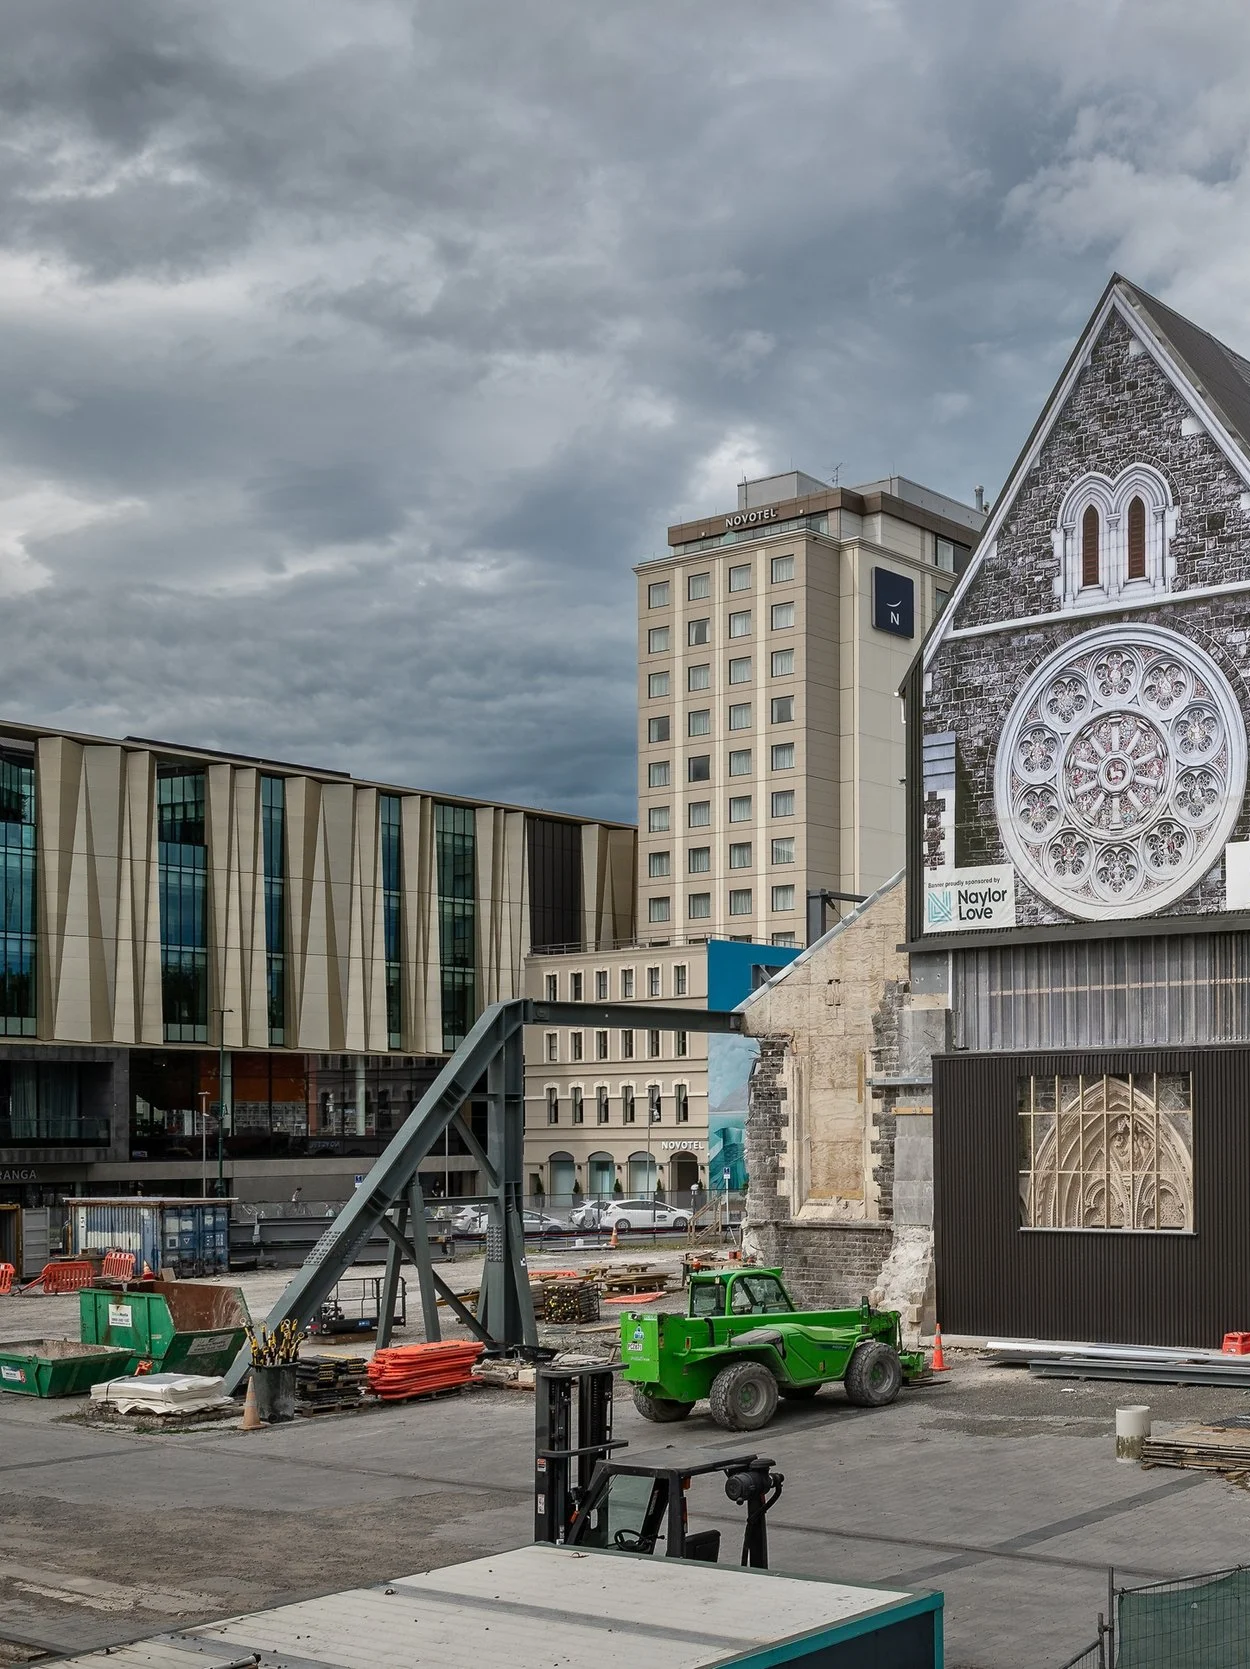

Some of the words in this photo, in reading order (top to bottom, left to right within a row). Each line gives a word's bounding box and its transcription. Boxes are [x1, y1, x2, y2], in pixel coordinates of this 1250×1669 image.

[725, 508, 777, 527] NOVOTEL
[890, 611, 900, 625] N
[945, 880, 964, 888] proudly
[965, 877, 993, 886] sponsored
[958, 888, 1007, 907] Naylor
[959, 906, 993, 921] Love
[661, 1141, 705, 1150] NOVOTEL
